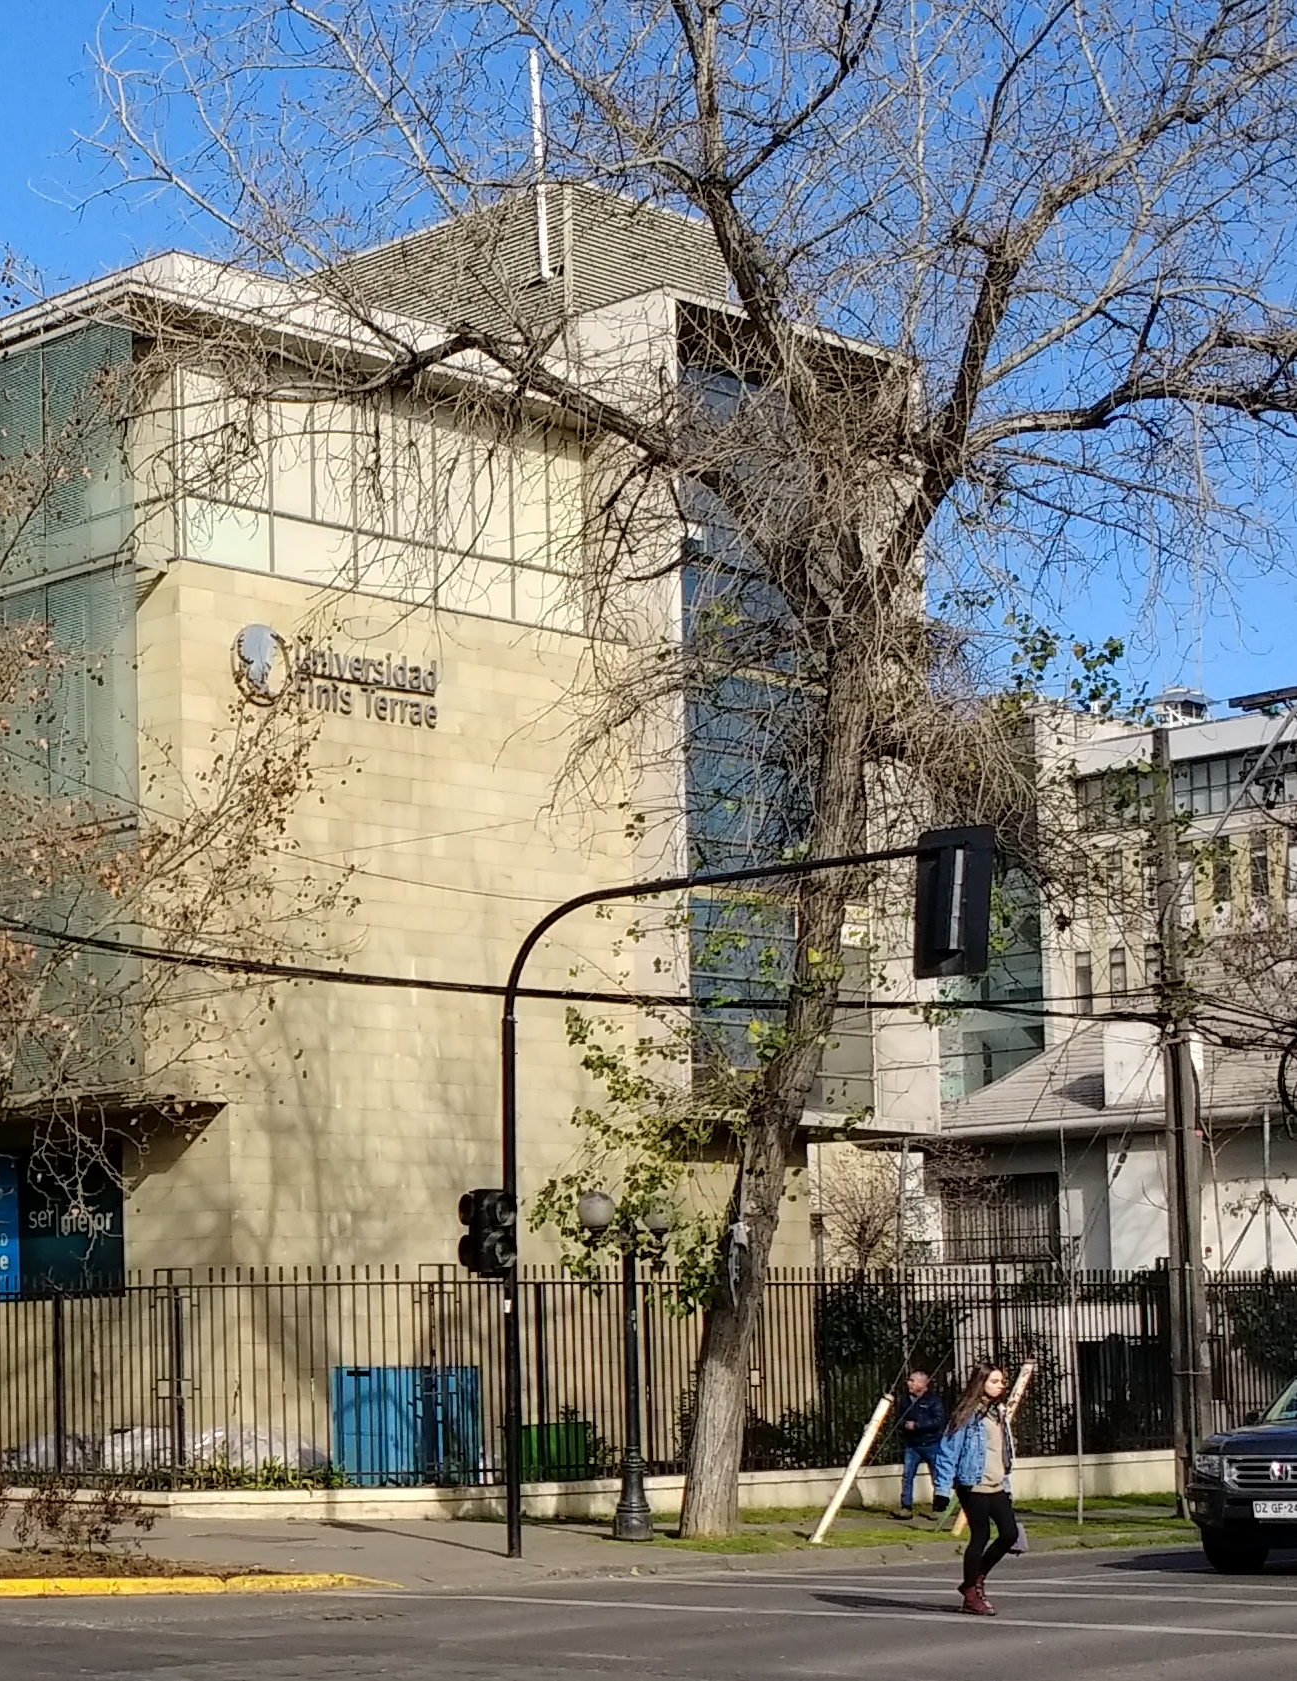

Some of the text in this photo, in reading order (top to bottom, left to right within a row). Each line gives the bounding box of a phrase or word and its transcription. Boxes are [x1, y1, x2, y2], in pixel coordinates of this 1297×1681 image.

[295, 643, 437, 691] Universidad
[295, 675, 437, 728] Finis Terrae
[28, 1209, 113, 1238] ser mejor
[1255, 1502, 1268, 1513] DZ
